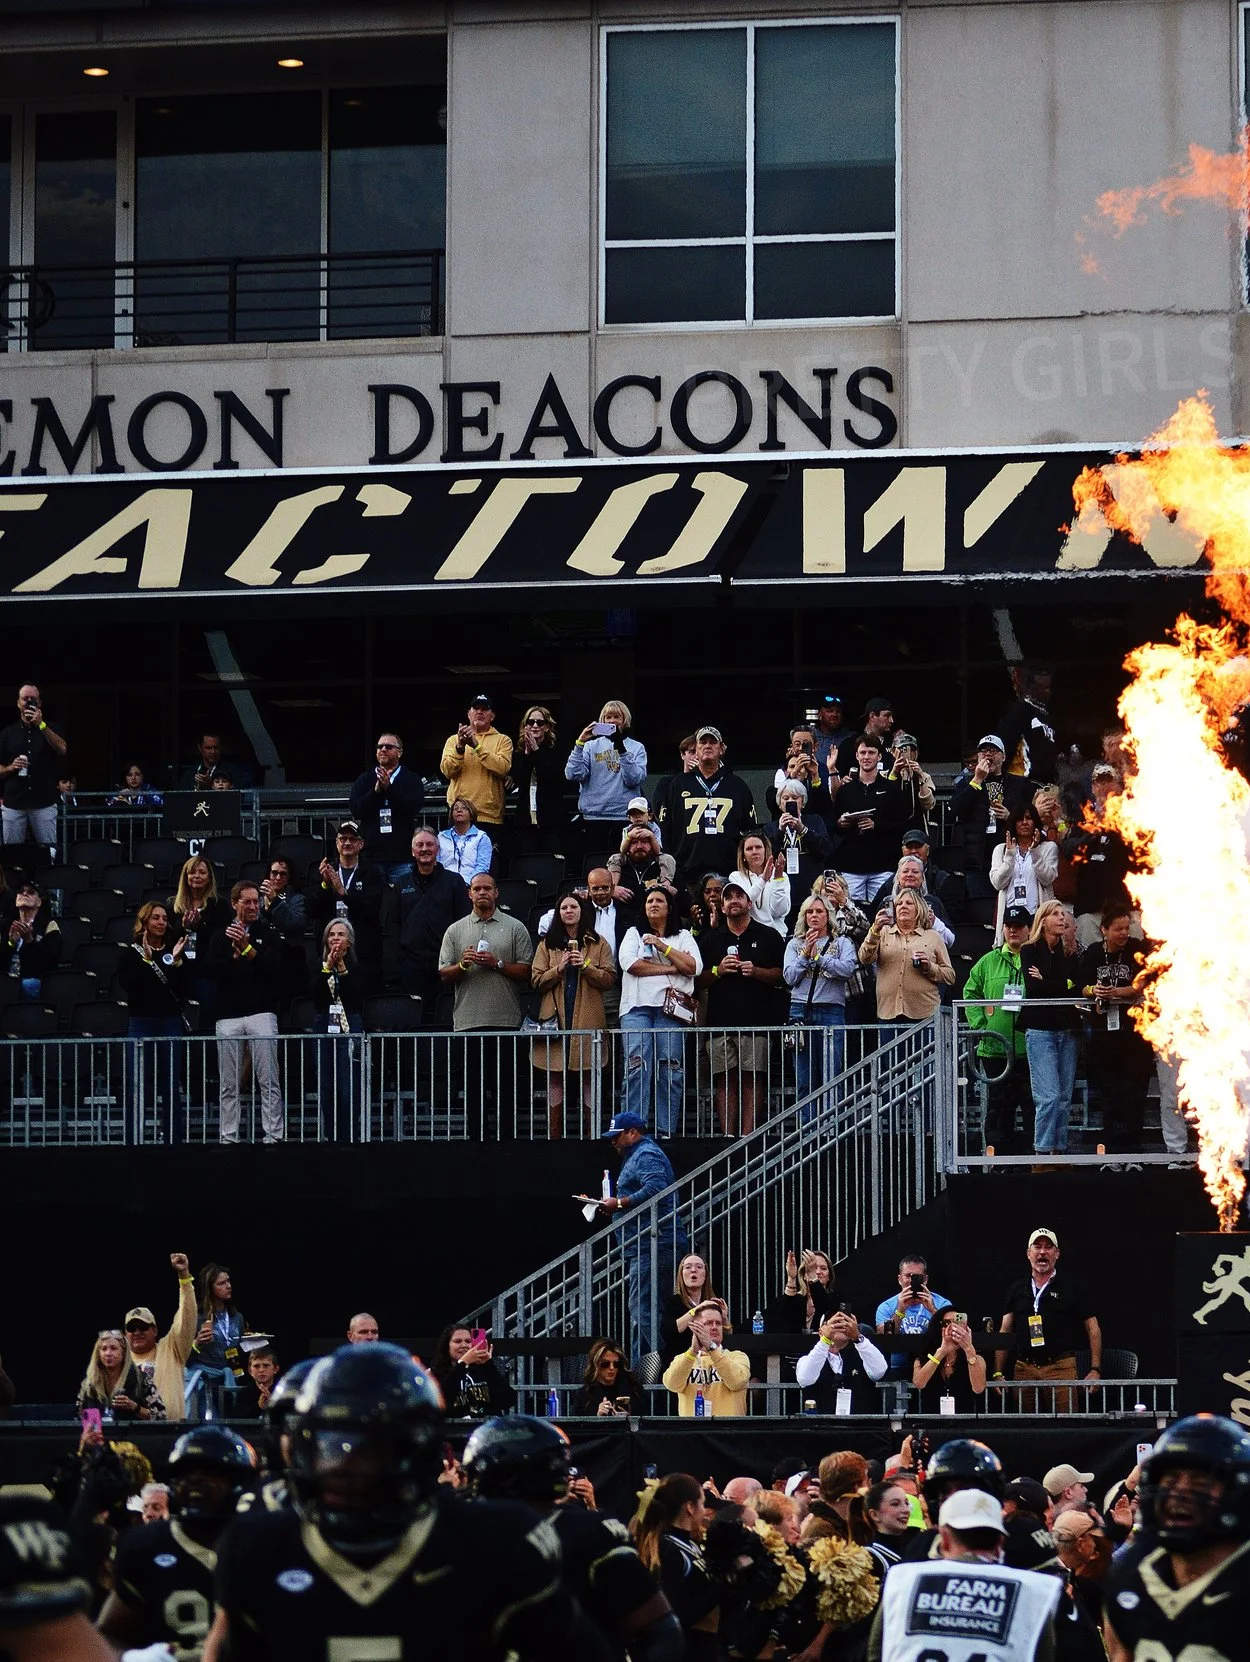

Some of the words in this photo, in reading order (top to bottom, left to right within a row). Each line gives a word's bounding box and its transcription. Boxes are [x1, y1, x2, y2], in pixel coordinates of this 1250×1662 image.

[0, 389, 290, 477] MON
[367, 366, 898, 465] DEACONS
[684, 797, 734, 835] 77
[945, 1578, 1007, 1600] FARM
[916, 1592, 1007, 1617] BUREAU
[928, 1614, 1001, 1634] INSURANCE
